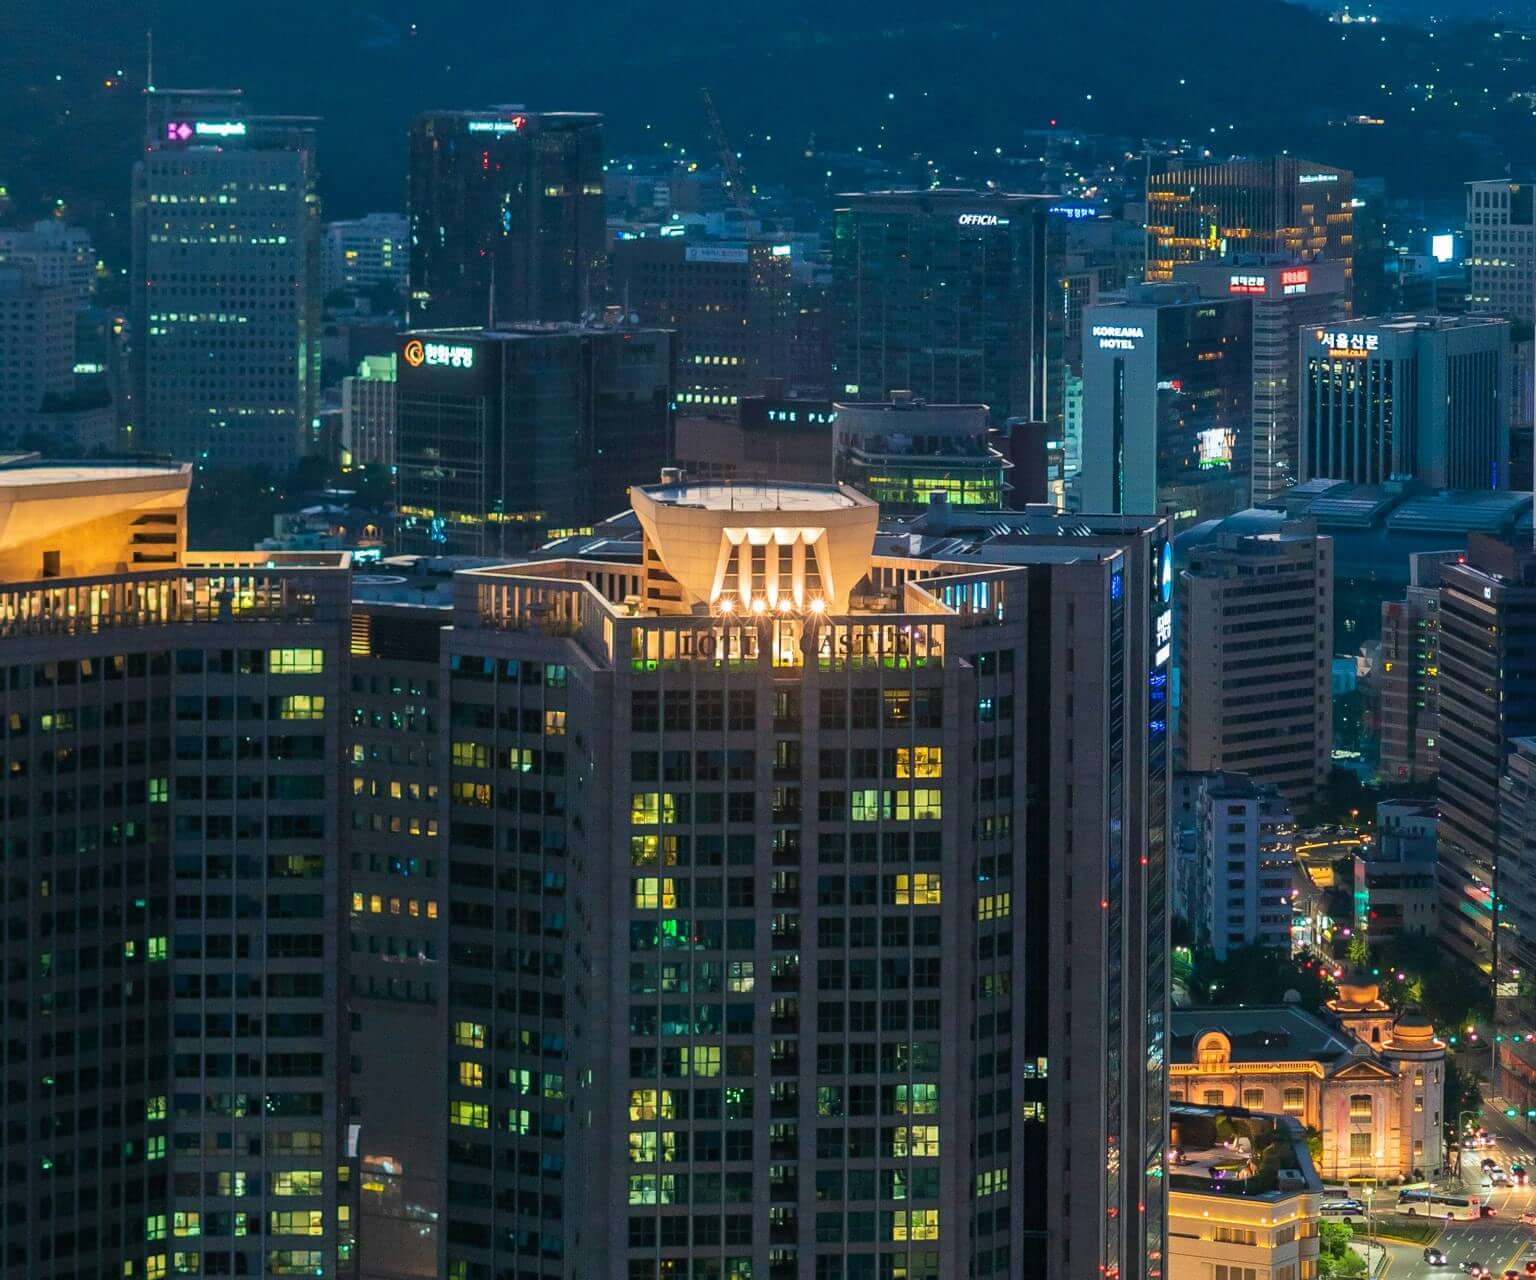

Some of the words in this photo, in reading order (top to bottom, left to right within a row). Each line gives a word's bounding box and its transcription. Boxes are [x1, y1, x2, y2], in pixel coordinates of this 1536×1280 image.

[959, 214, 997, 225] OFFICIA
[1092, 326, 1144, 337] KOREANA
[1100, 339, 1135, 349] HOTEL
[1321, 333, 1379, 350] 서울신문
[768, 410, 796, 421] THE
